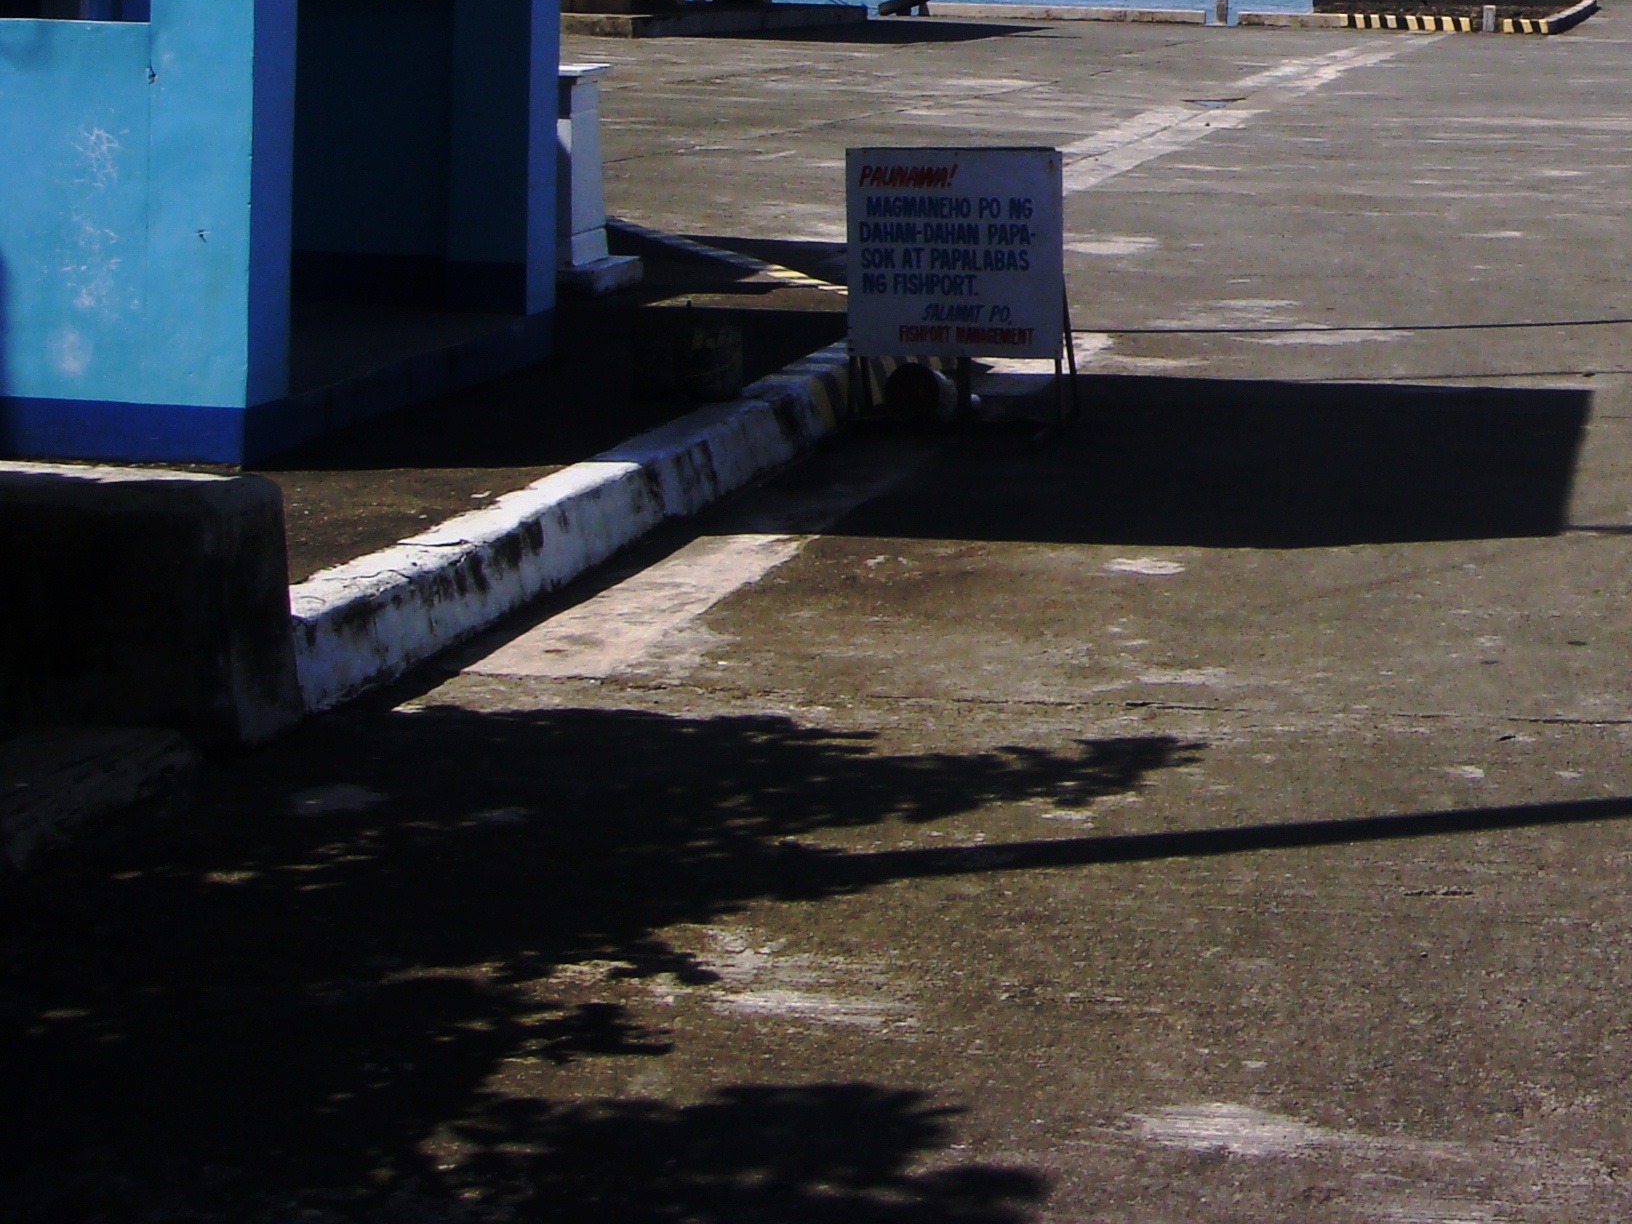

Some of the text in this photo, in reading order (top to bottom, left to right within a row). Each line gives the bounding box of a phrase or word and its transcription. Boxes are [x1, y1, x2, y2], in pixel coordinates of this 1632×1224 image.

[858, 164, 958, 188] PAUNAWA!
[866, 196, 1035, 220] MAGMANEHO PO NG
[859, 221, 1036, 246] DAHAN-DAHAN PAPA-
[861, 247, 1030, 272] SOK AT PAPALABAS
[862, 273, 979, 297] NG FISHPORT.
[922, 303, 985, 322] SALAMAT
[900, 324, 1035, 346] FISHPORT MANAGEMENT
